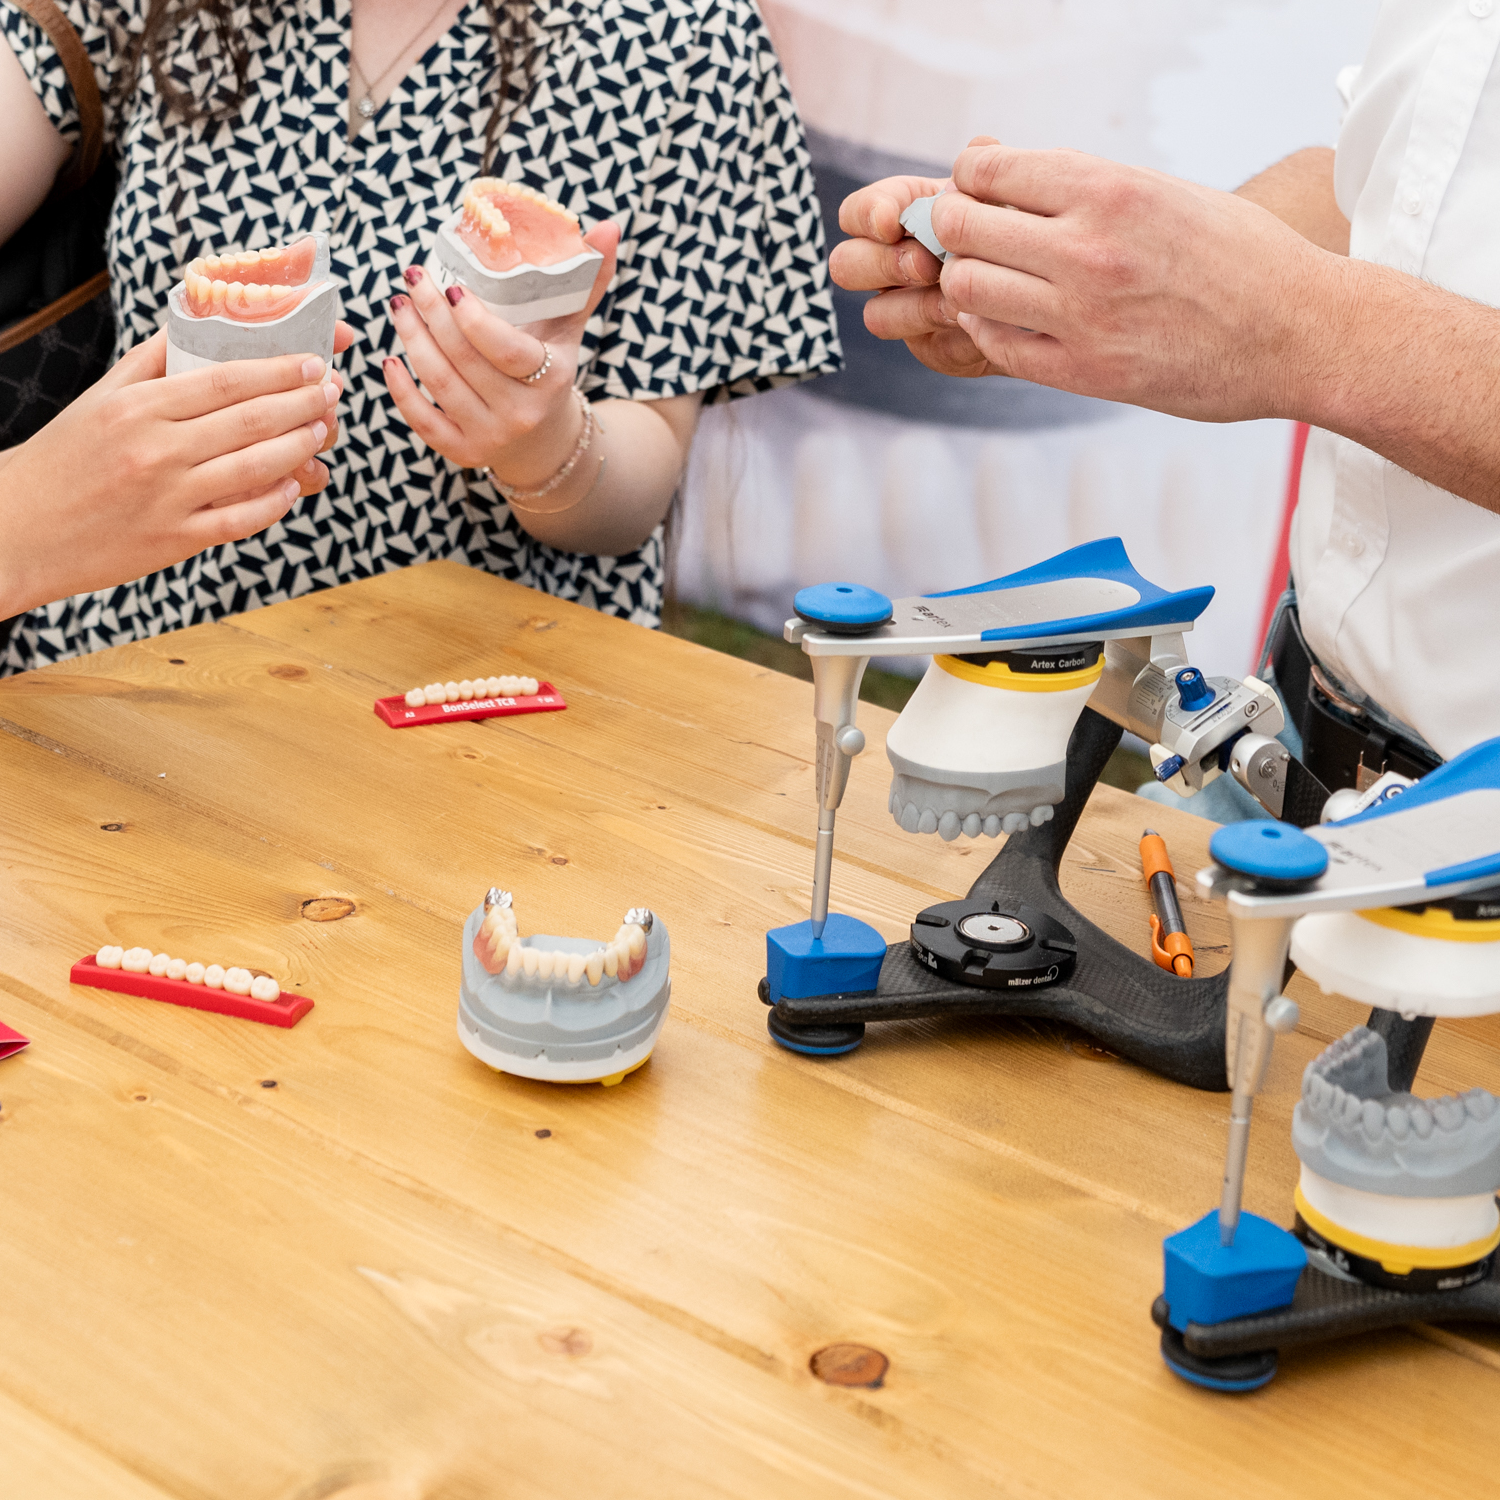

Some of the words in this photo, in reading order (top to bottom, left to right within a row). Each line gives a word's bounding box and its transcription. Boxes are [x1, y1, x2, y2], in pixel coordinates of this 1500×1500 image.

[1031, 660, 1056, 669] Artex
[1058, 657, 1086, 669] Carbon
[441, 700, 496, 713] BonSelect
[495, 697, 517, 707] TCR
[1033, 974, 1053, 985] dental
